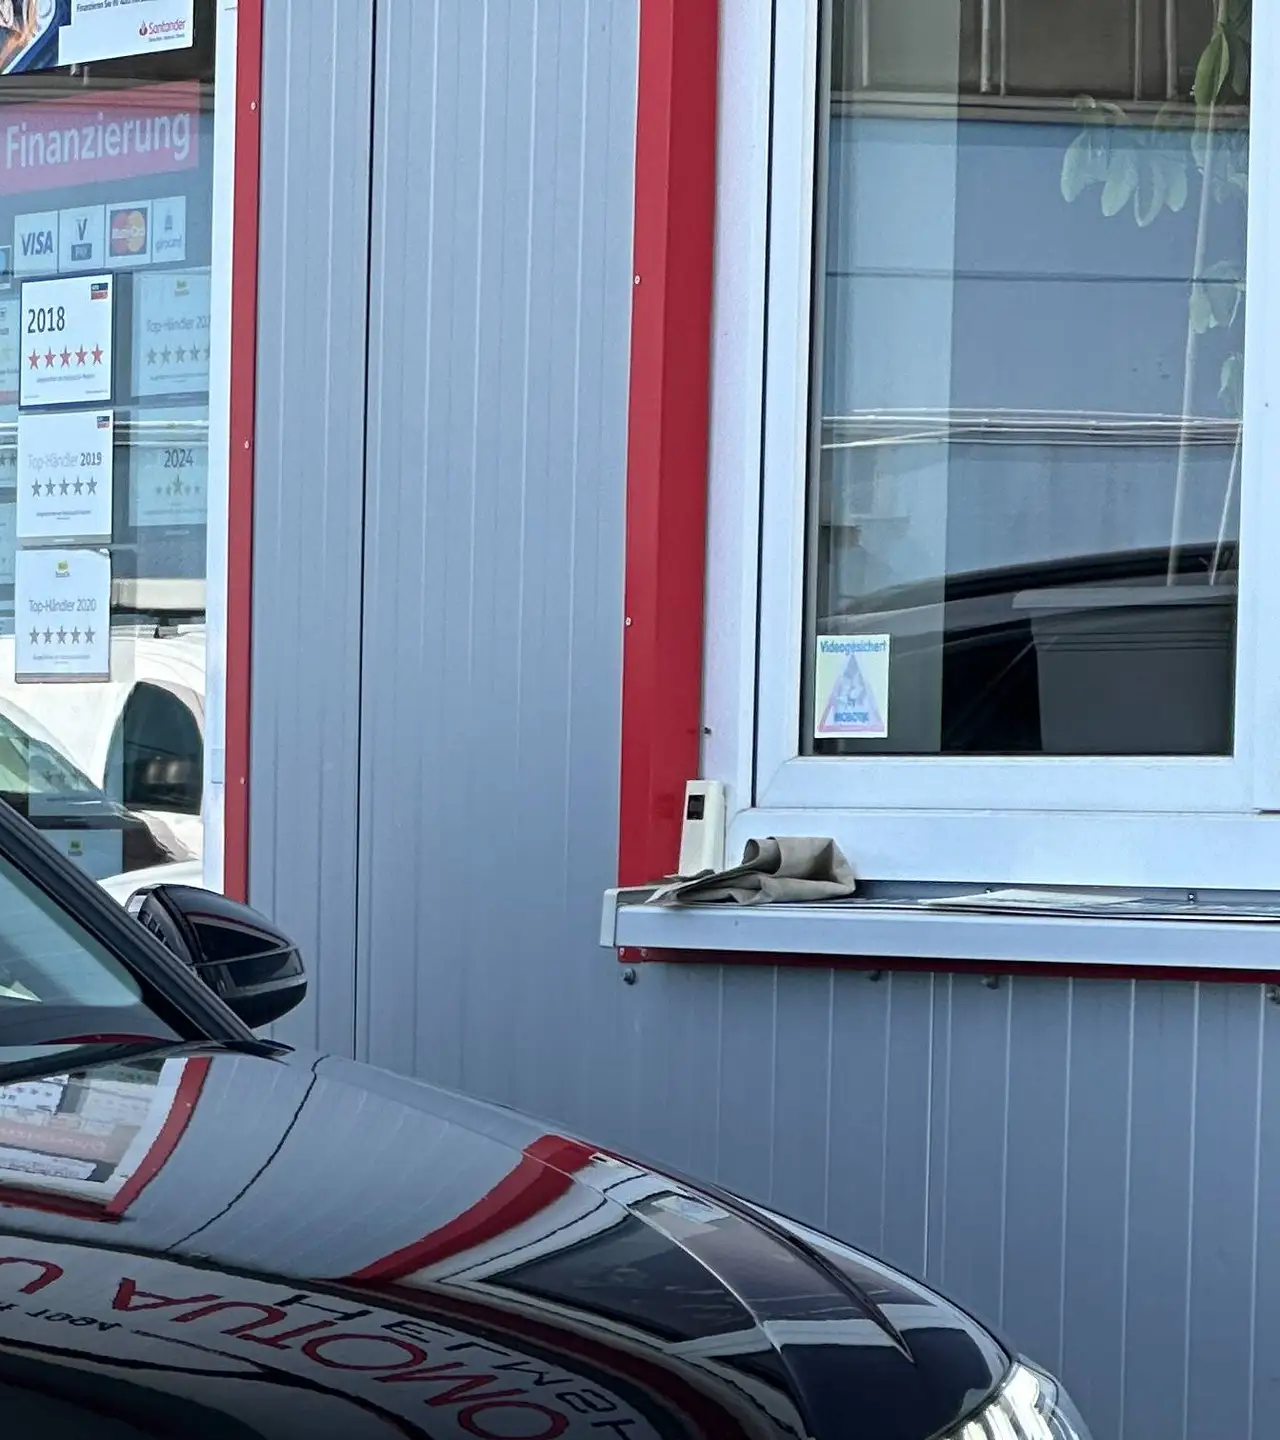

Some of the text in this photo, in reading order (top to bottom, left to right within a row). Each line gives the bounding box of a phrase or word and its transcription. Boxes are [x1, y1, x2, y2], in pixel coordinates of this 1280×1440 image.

[148, 18, 187, 35] Santander
[6, 111, 191, 170] Finanzierung
[21, 231, 54, 257] VISA
[27, 306, 65, 334] 2018
[80, 452, 102, 467] 2019
[163, 448, 194, 469] 2024
[76, 598, 97, 612] 2020
[820, 640, 887, 656] Videogesichert
